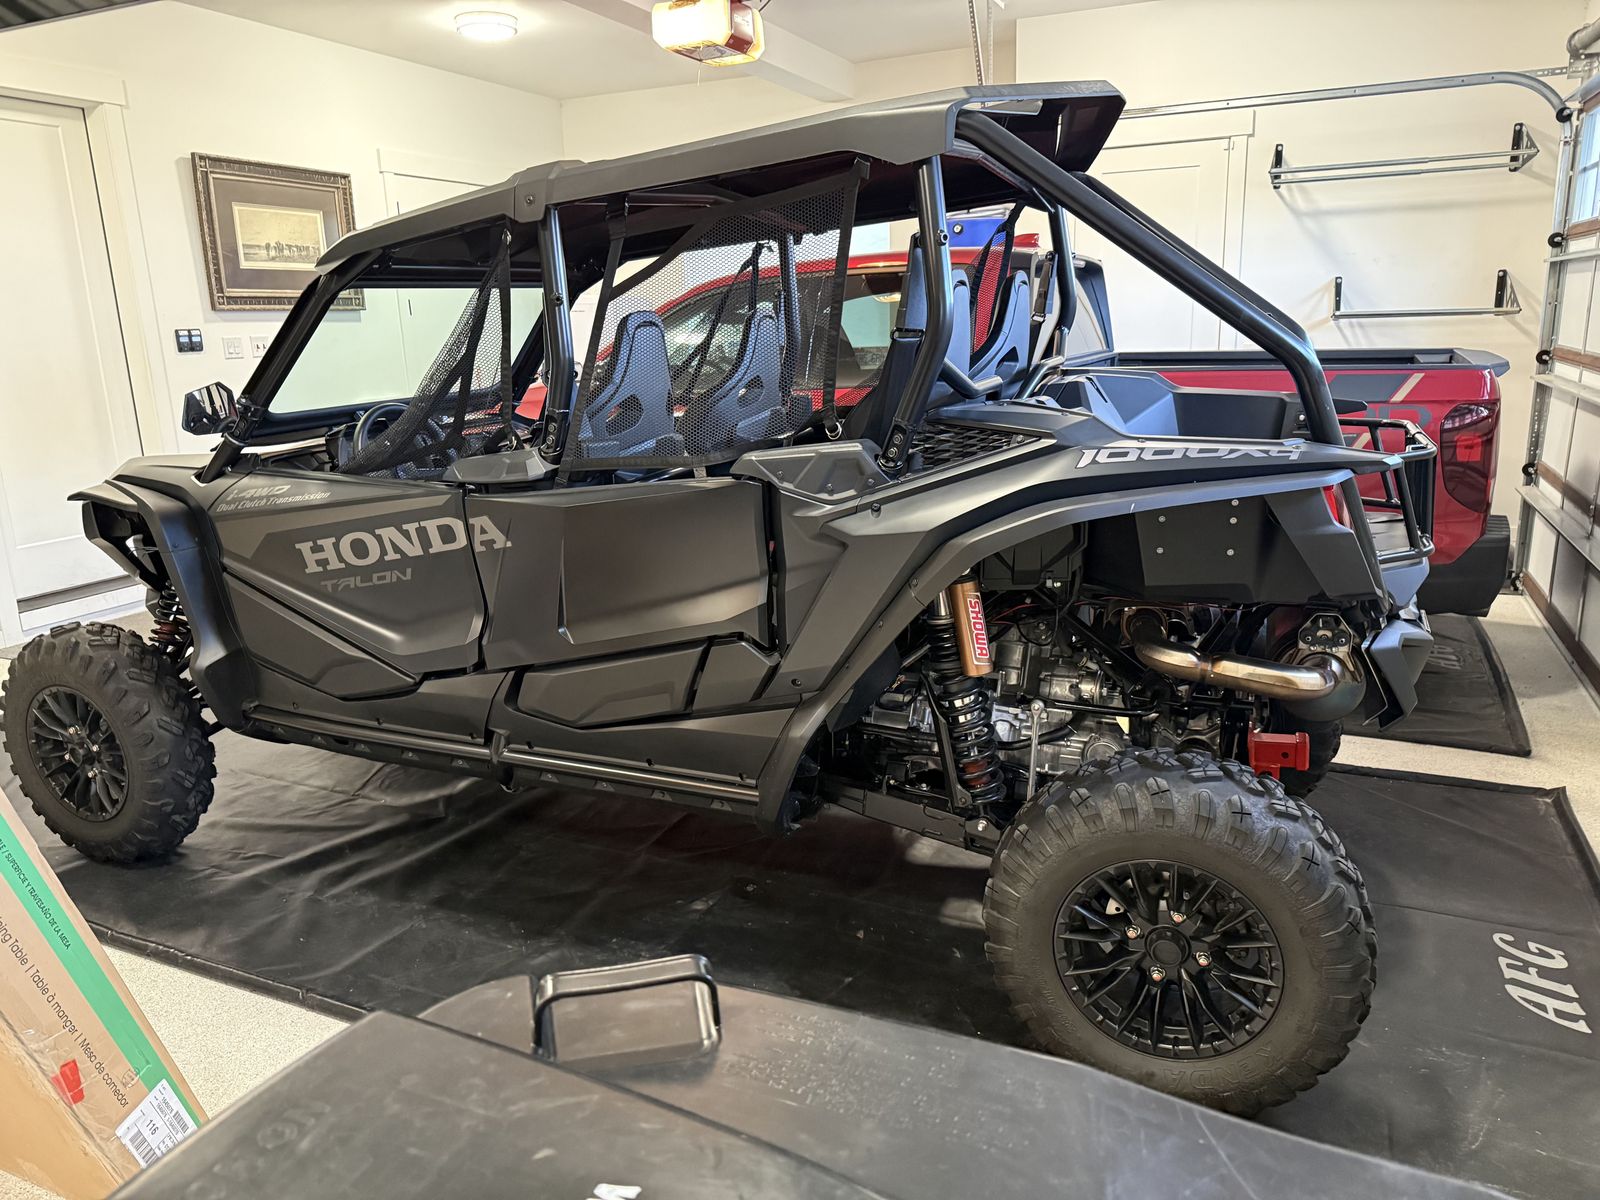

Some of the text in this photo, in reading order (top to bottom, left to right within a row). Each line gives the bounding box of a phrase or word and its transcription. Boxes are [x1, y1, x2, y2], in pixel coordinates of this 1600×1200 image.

[217, 491, 332, 513] Dual Clutch Transmission
[295, 515, 512, 574] HONDA
[320, 567, 412, 592] TALON
[967, 598, 989, 658] SHOWA
[48, 917, 58, 928] DE
[53, 925, 62, 936] LA
[59, 932, 71, 950] MESA
[1492, 933, 1592, 1034] AFG
[8, 938, 29, 966] Table
[30, 968, 49, 996] Table
[46, 993, 56, 1003] à
[51, 1001, 79, 1036] manger
[79, 1038, 97, 1063] Mesa
[94, 1059, 105, 1075] de
[102, 1072, 129, 1109] comedor
[145, 1119, 160, 1136] 116
